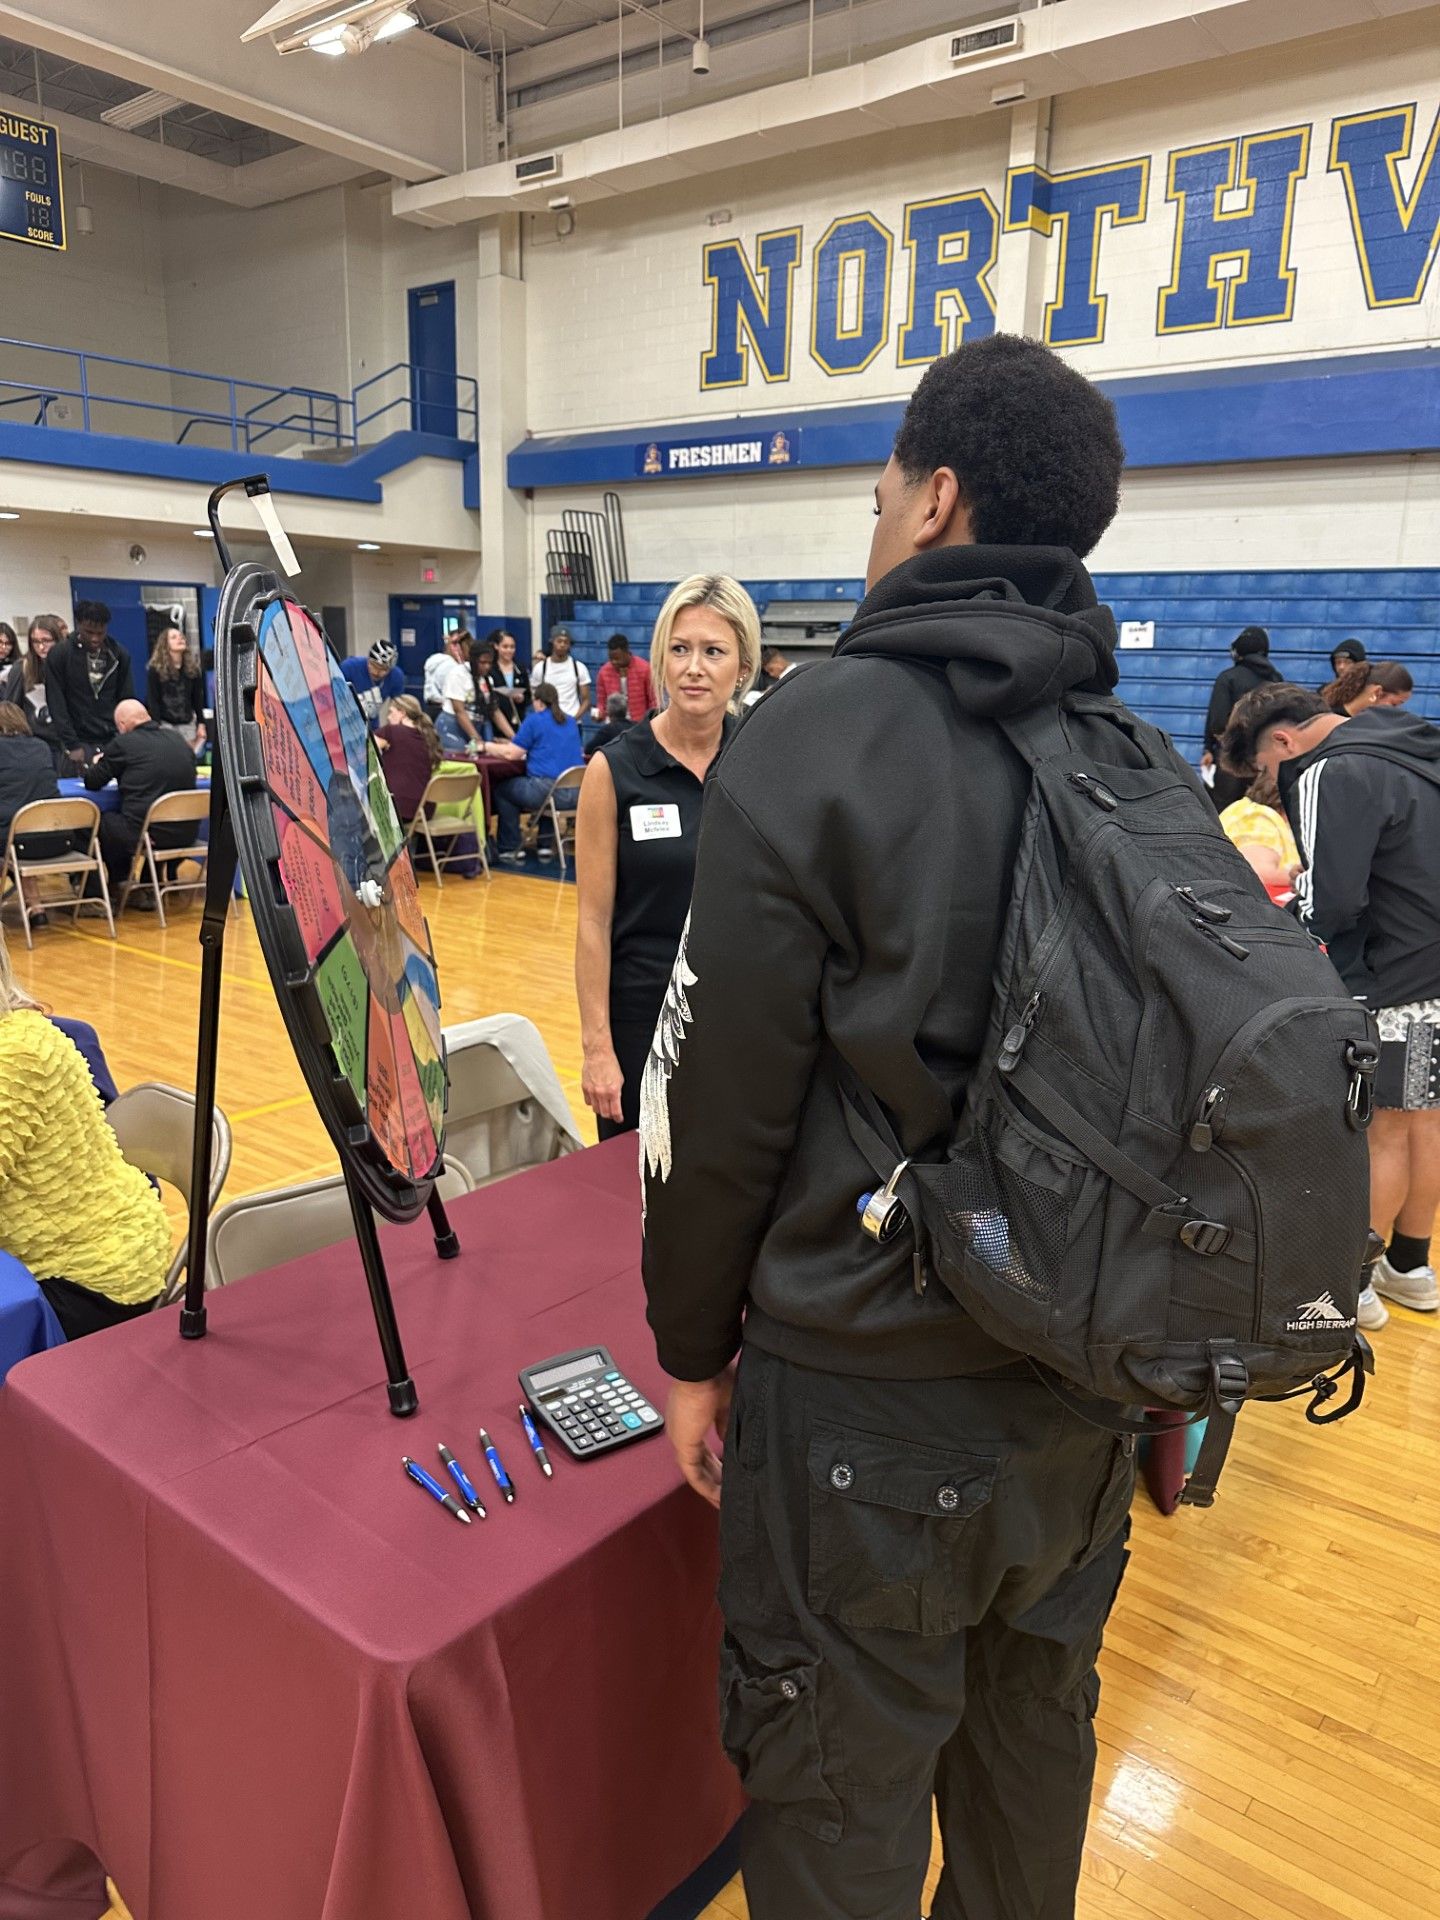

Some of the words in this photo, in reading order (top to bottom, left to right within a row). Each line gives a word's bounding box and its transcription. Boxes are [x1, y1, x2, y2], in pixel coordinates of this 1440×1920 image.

[0, 115, 48, 146] GUEST
[25, 191, 52, 206] FOULS
[27, 227, 54, 242] SCORE
[668, 441, 763, 469] FRESHMEN
[1286, 1321, 1315, 1331] HIGH
[1316, 1320, 1351, 1329] SIERRA
